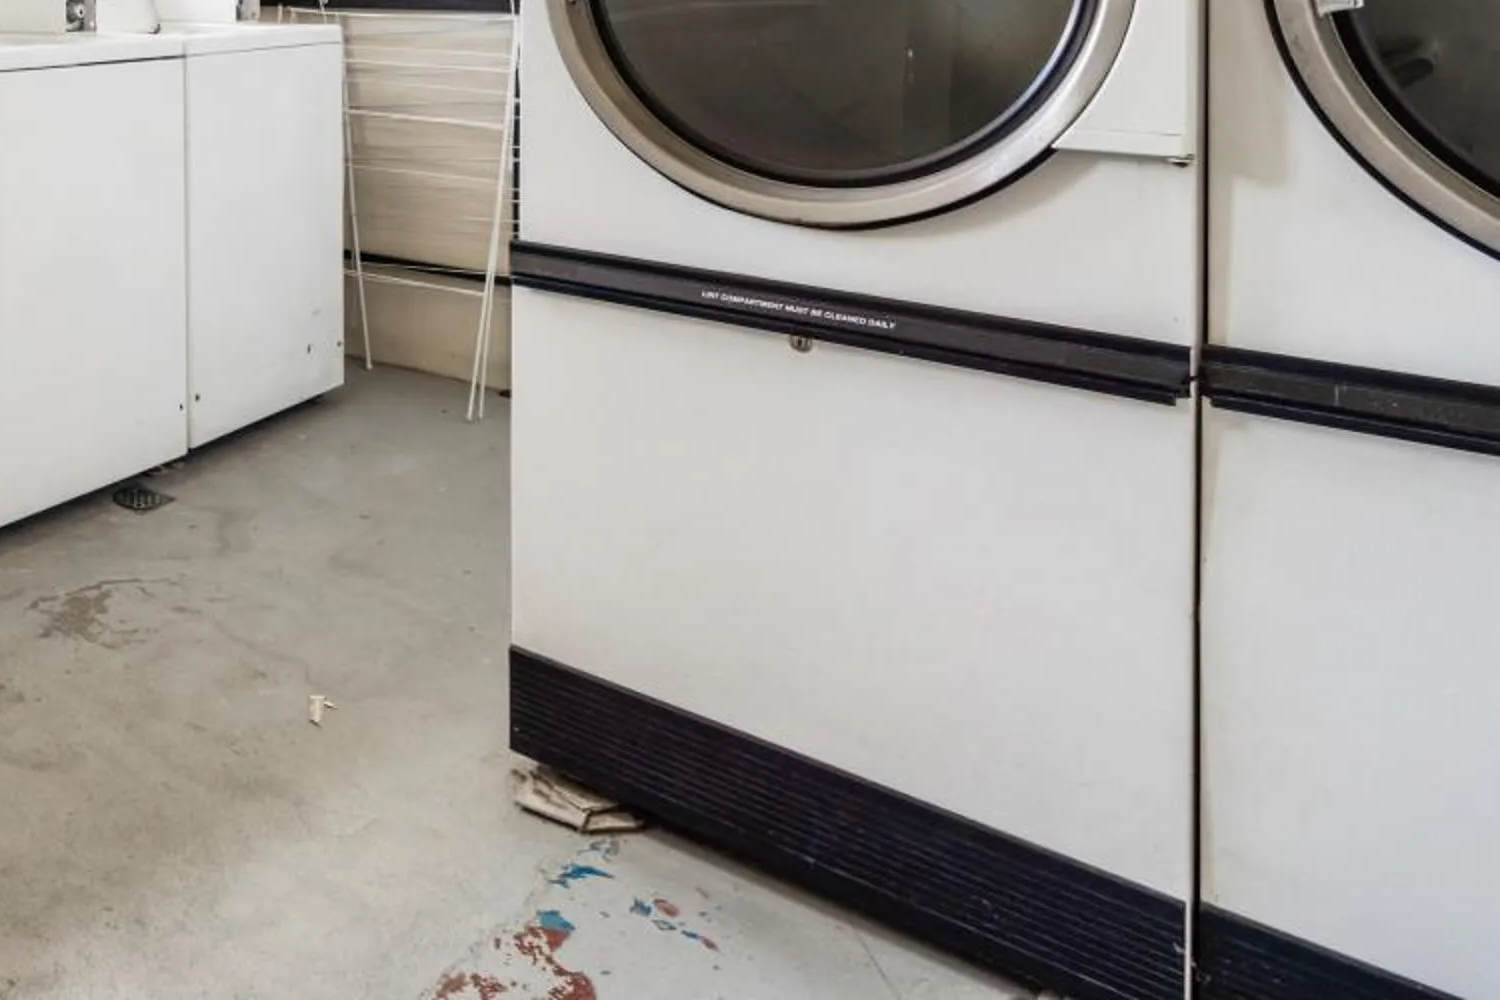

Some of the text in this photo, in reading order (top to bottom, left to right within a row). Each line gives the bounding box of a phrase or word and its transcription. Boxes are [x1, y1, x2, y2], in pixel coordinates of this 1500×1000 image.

[785, 303, 810, 315] MUST
[810, 309, 823, 318] BE
[823, 311, 867, 325] CLEANED
